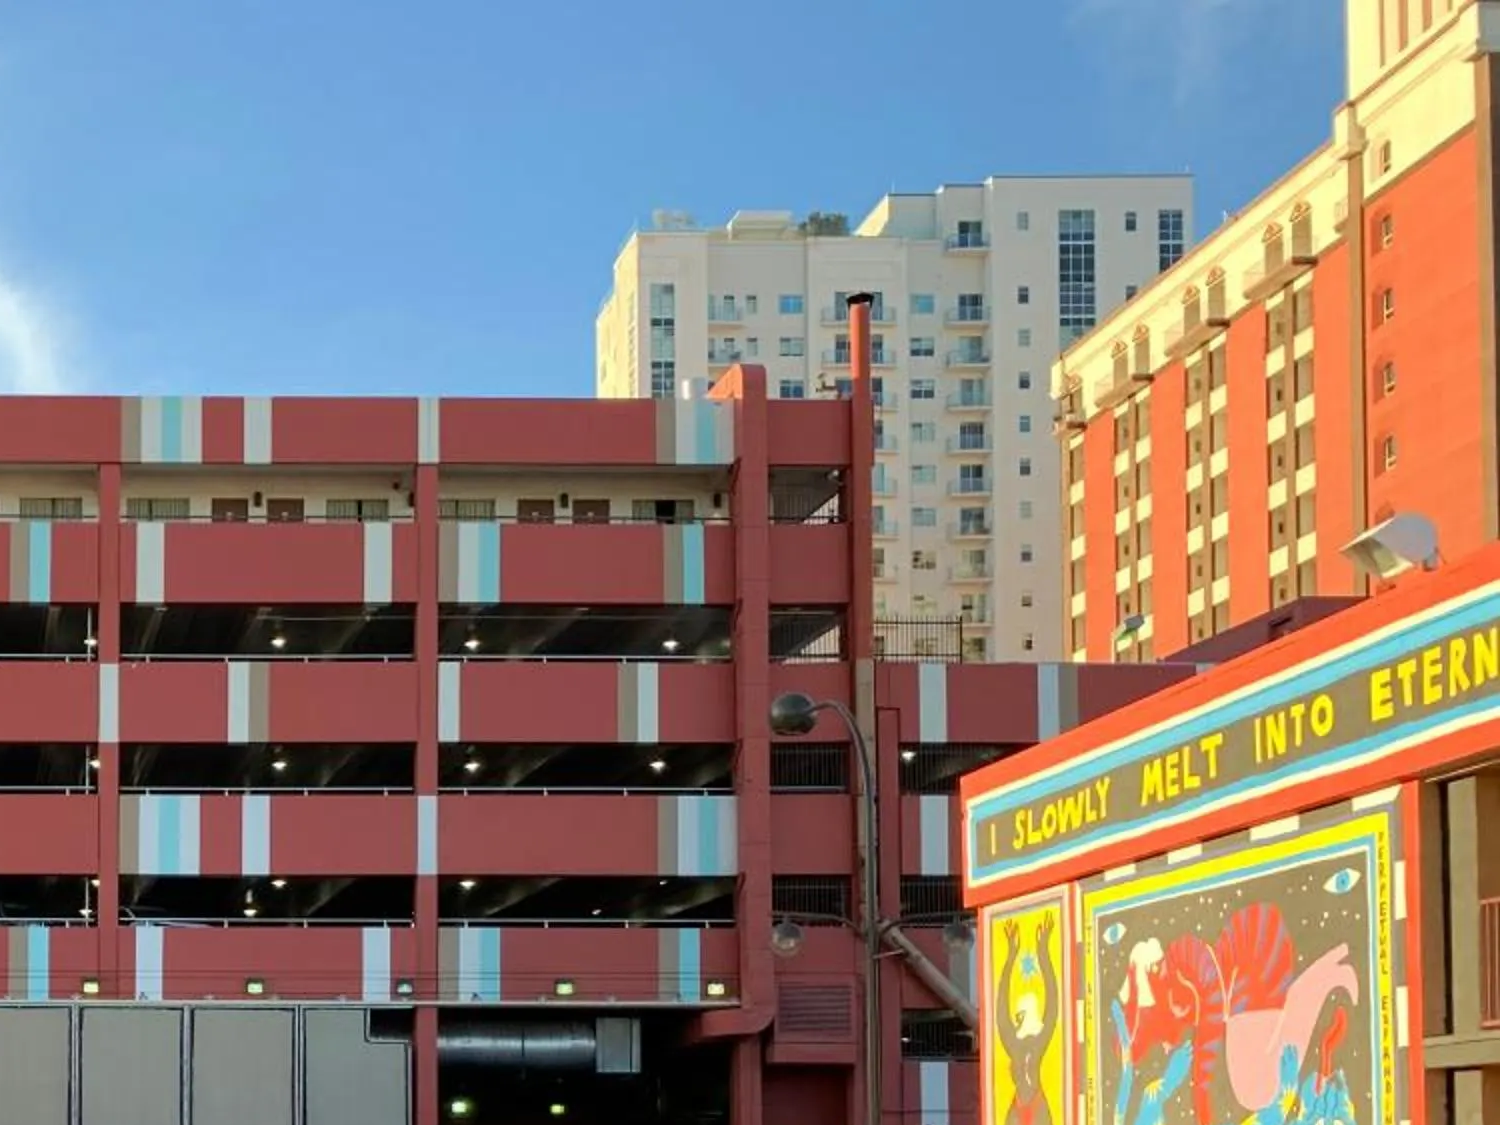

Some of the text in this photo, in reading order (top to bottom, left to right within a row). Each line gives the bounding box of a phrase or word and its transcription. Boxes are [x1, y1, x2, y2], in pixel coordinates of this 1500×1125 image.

[990, 627, 1498, 856] I SLOWLY MELT INTO ETERN
